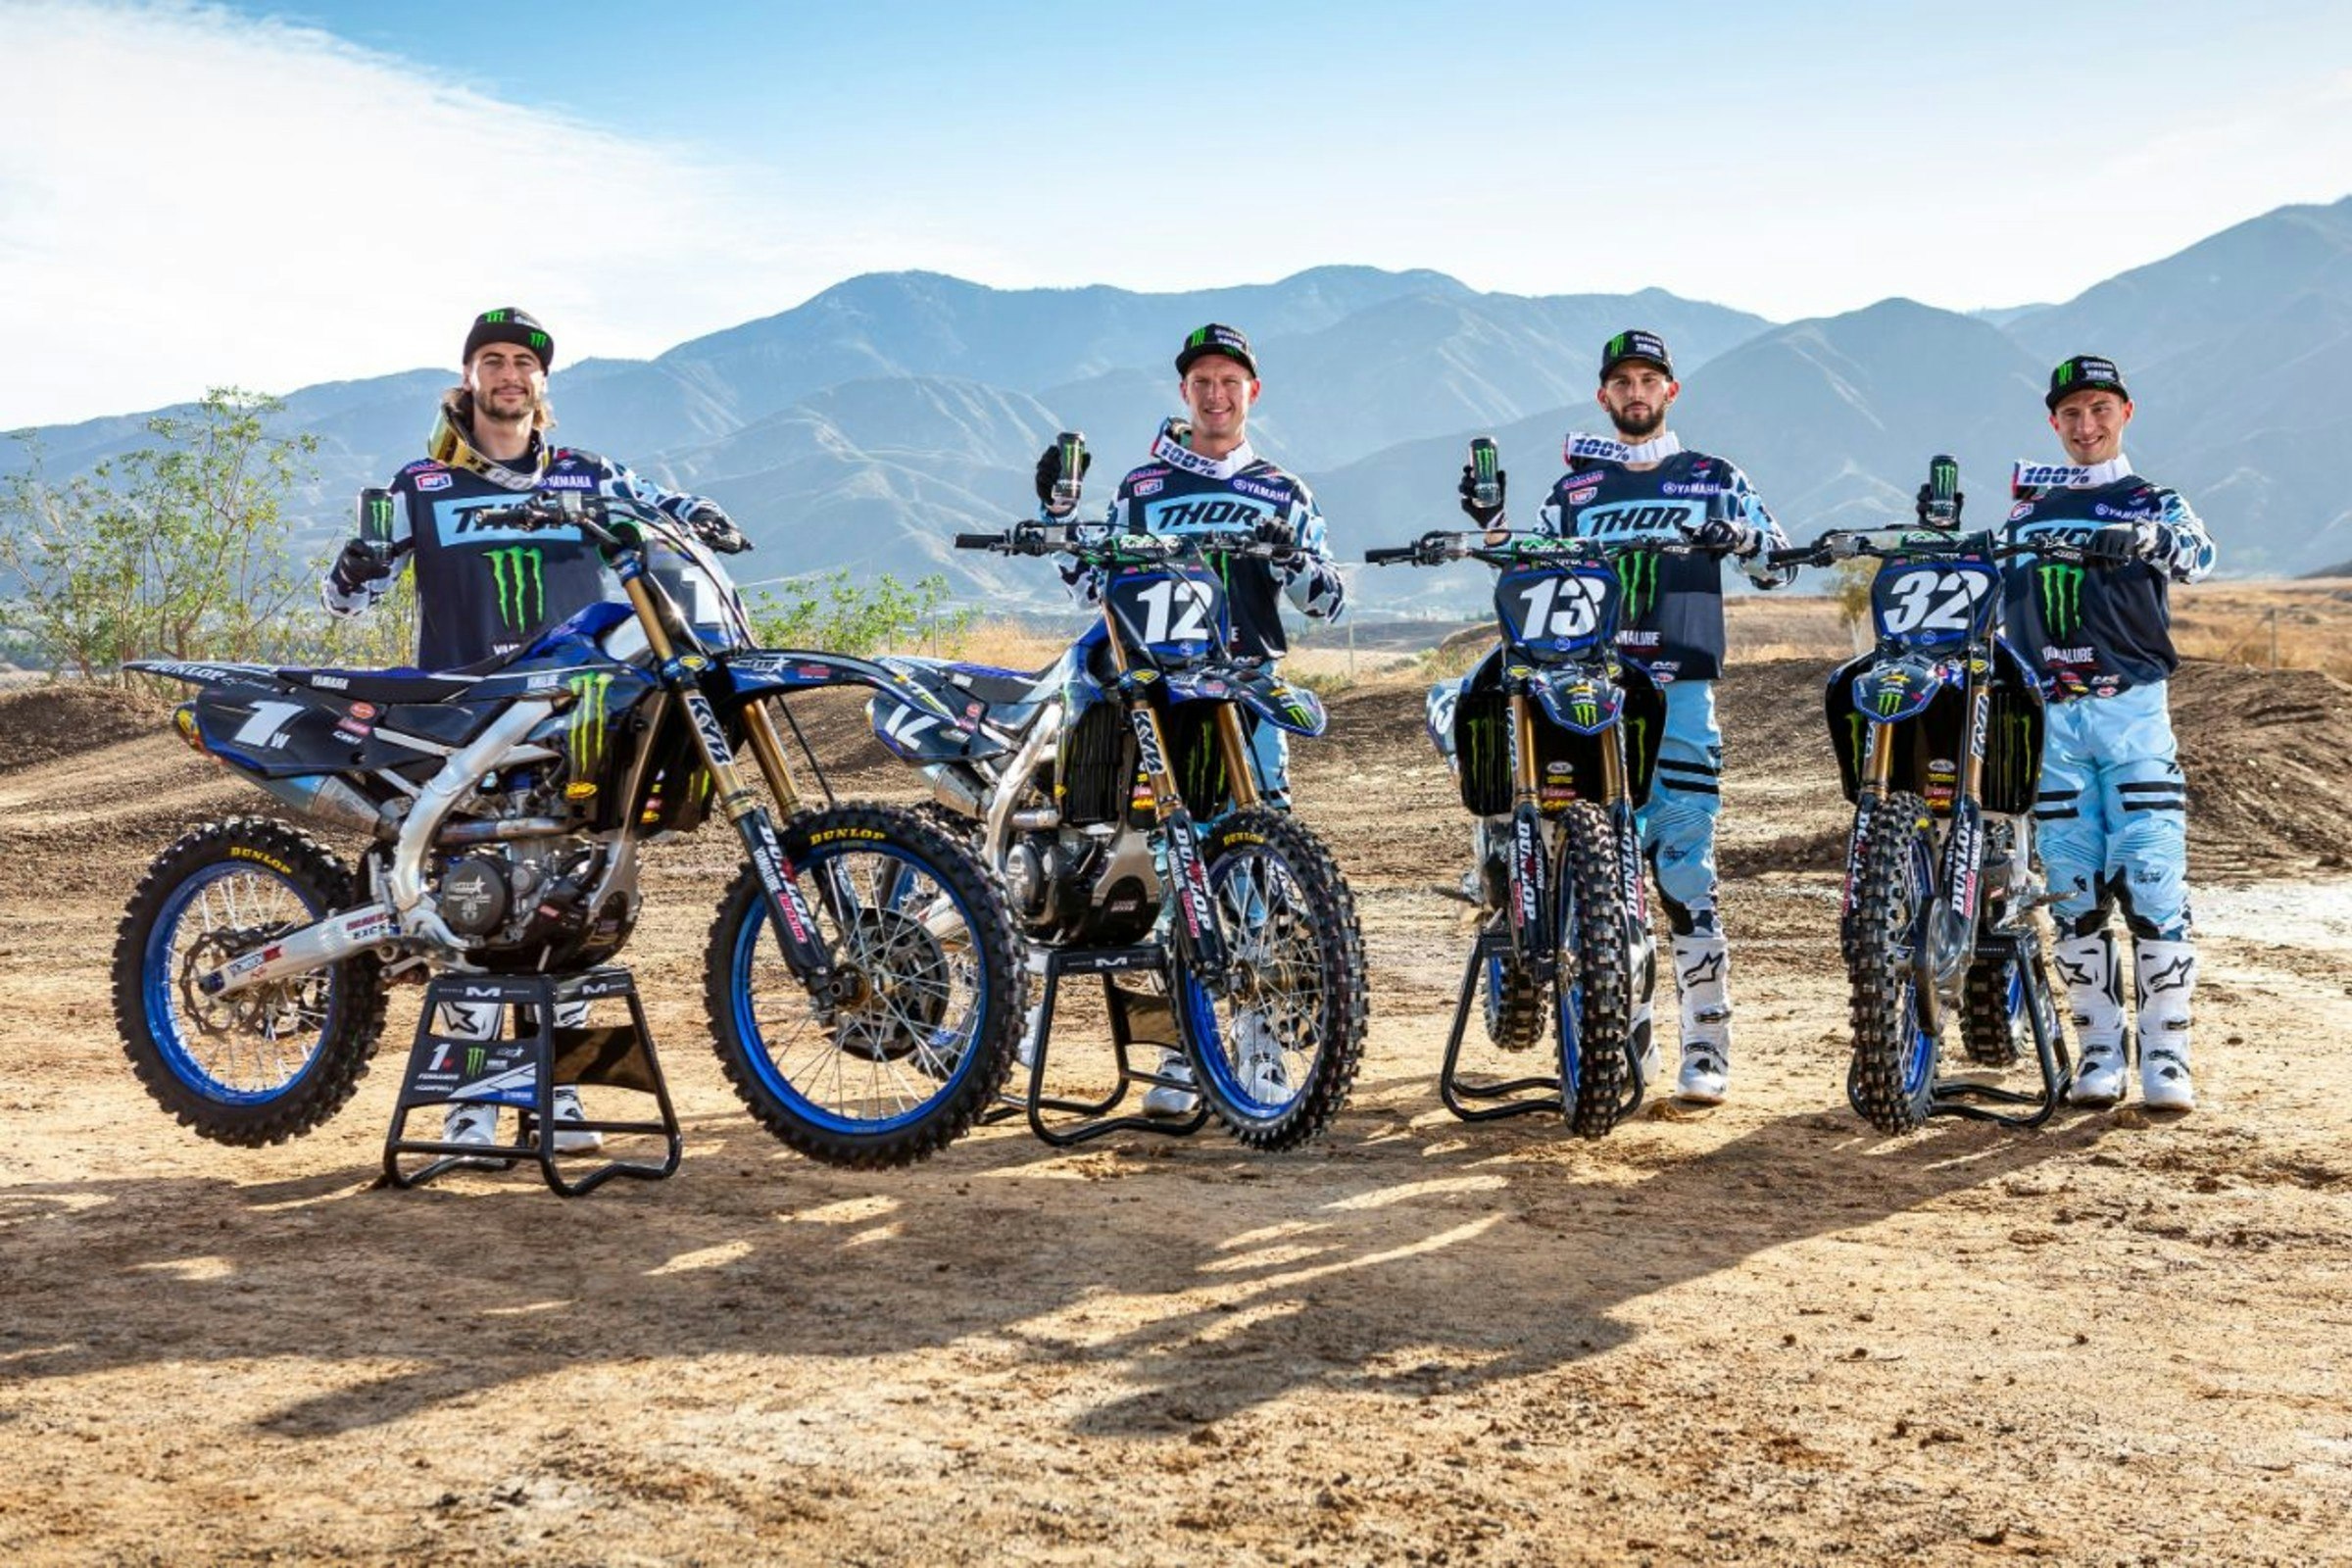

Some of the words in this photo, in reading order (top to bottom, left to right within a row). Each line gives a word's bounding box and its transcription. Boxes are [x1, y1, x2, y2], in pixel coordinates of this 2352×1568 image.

[1160, 442, 1217, 476] 100%
[1573, 437, 1630, 462] 100%
[547, 474, 593, 488] YAMAHA
[2024, 466, 2089, 484] 100%
[1247, 482, 1292, 502] YAMAHA
[1158, 501, 1261, 530] THOR
[1592, 507, 1691, 538] THOR
[1137, 579, 1213, 644] 12
[1520, 576, 1606, 640] 13
[1883, 569, 1989, 634] 32
[145, 662, 228, 681] DUNLOP
[233, 700, 307, 748] 1
[270, 732, 292, 750] W
[686, 695, 733, 766] KYB
[809, 828, 886, 847] DUNLOP
[229, 845, 293, 875] DUNLOP
[428, 1043, 451, 1071] 1
